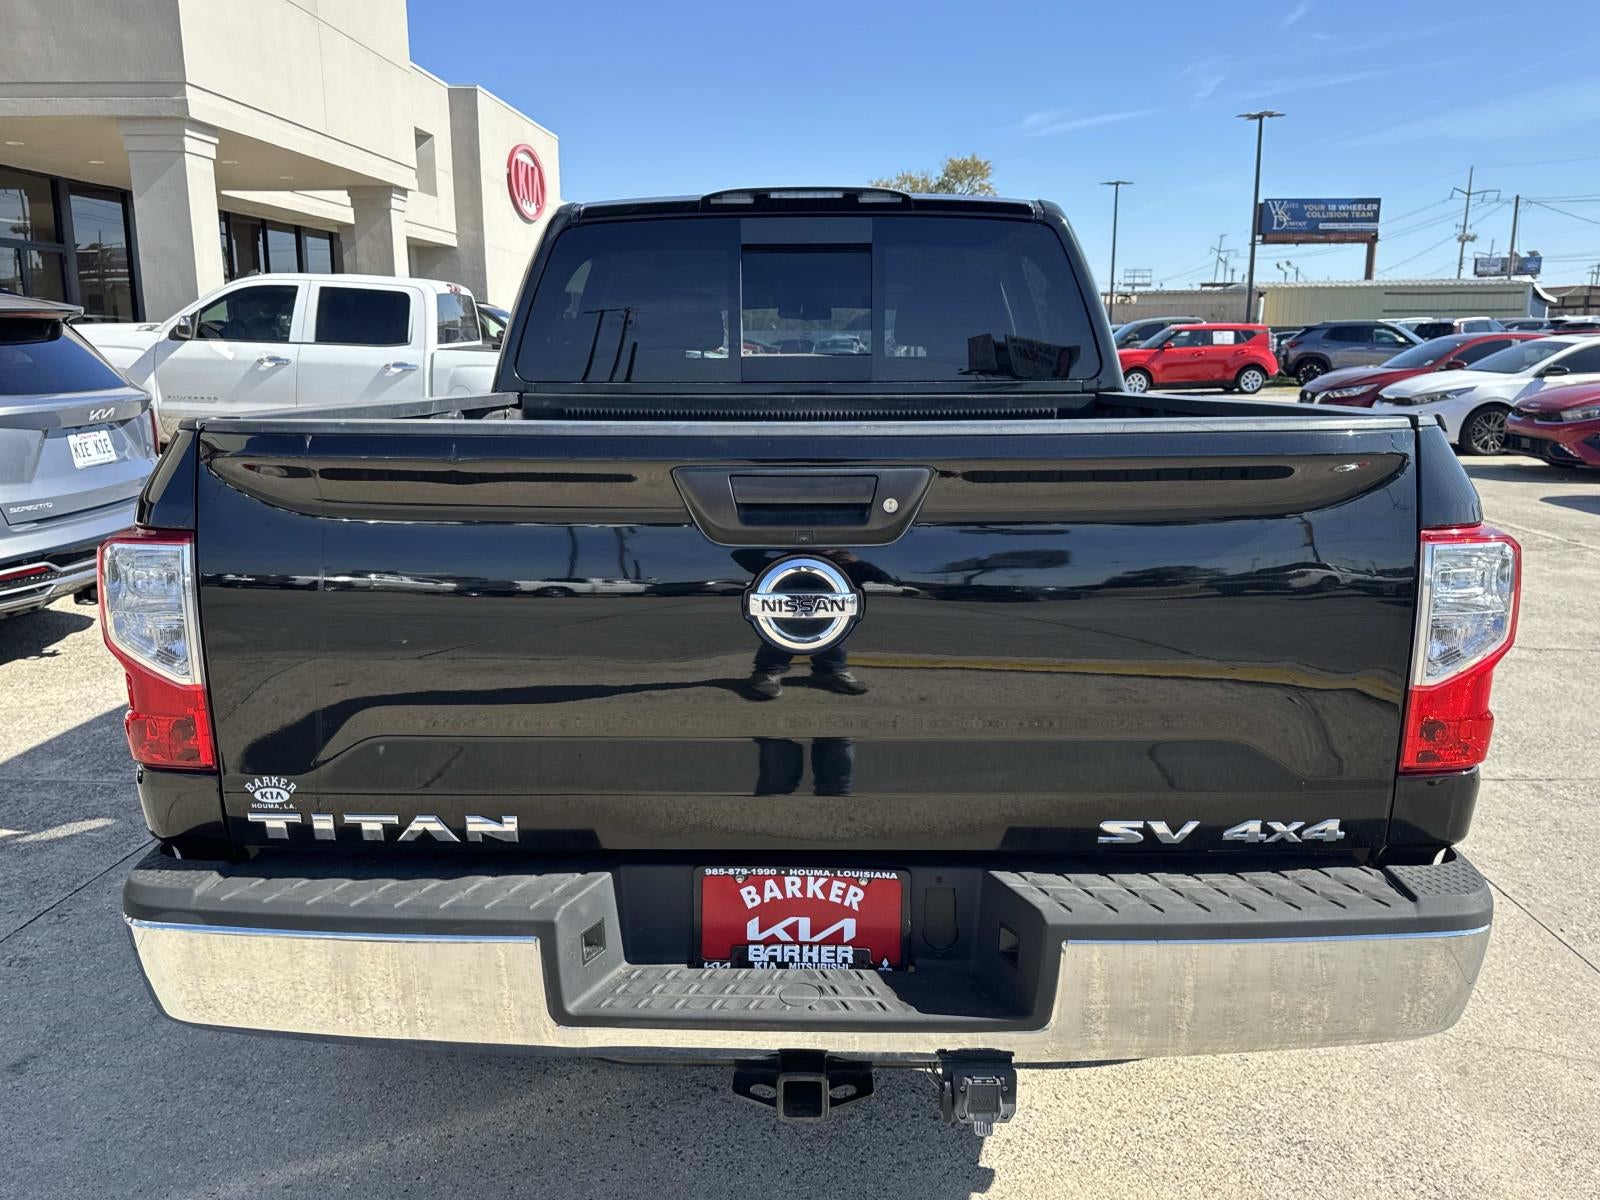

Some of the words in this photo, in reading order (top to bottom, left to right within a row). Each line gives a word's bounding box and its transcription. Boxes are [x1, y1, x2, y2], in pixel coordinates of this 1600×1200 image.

[517, 158, 543, 207] KIA
[89, 407, 115, 421] KIA
[73, 442, 92, 459] KIE
[93, 439, 111, 455] KIE
[761, 599, 846, 612] NISSAN
[245, 776, 297, 794] BARKER
[260, 791, 284, 800] KIA
[248, 813, 519, 843] TITAN
[1098, 820, 1200, 844] SV
[705, 868, 777, 876] 985-879-1990
[789, 868, 834, 877] HOUMA,
[837, 870, 898, 880] LOUISIANA
[739, 876, 865, 911] BARKER
[747, 916, 857, 943] KIA
